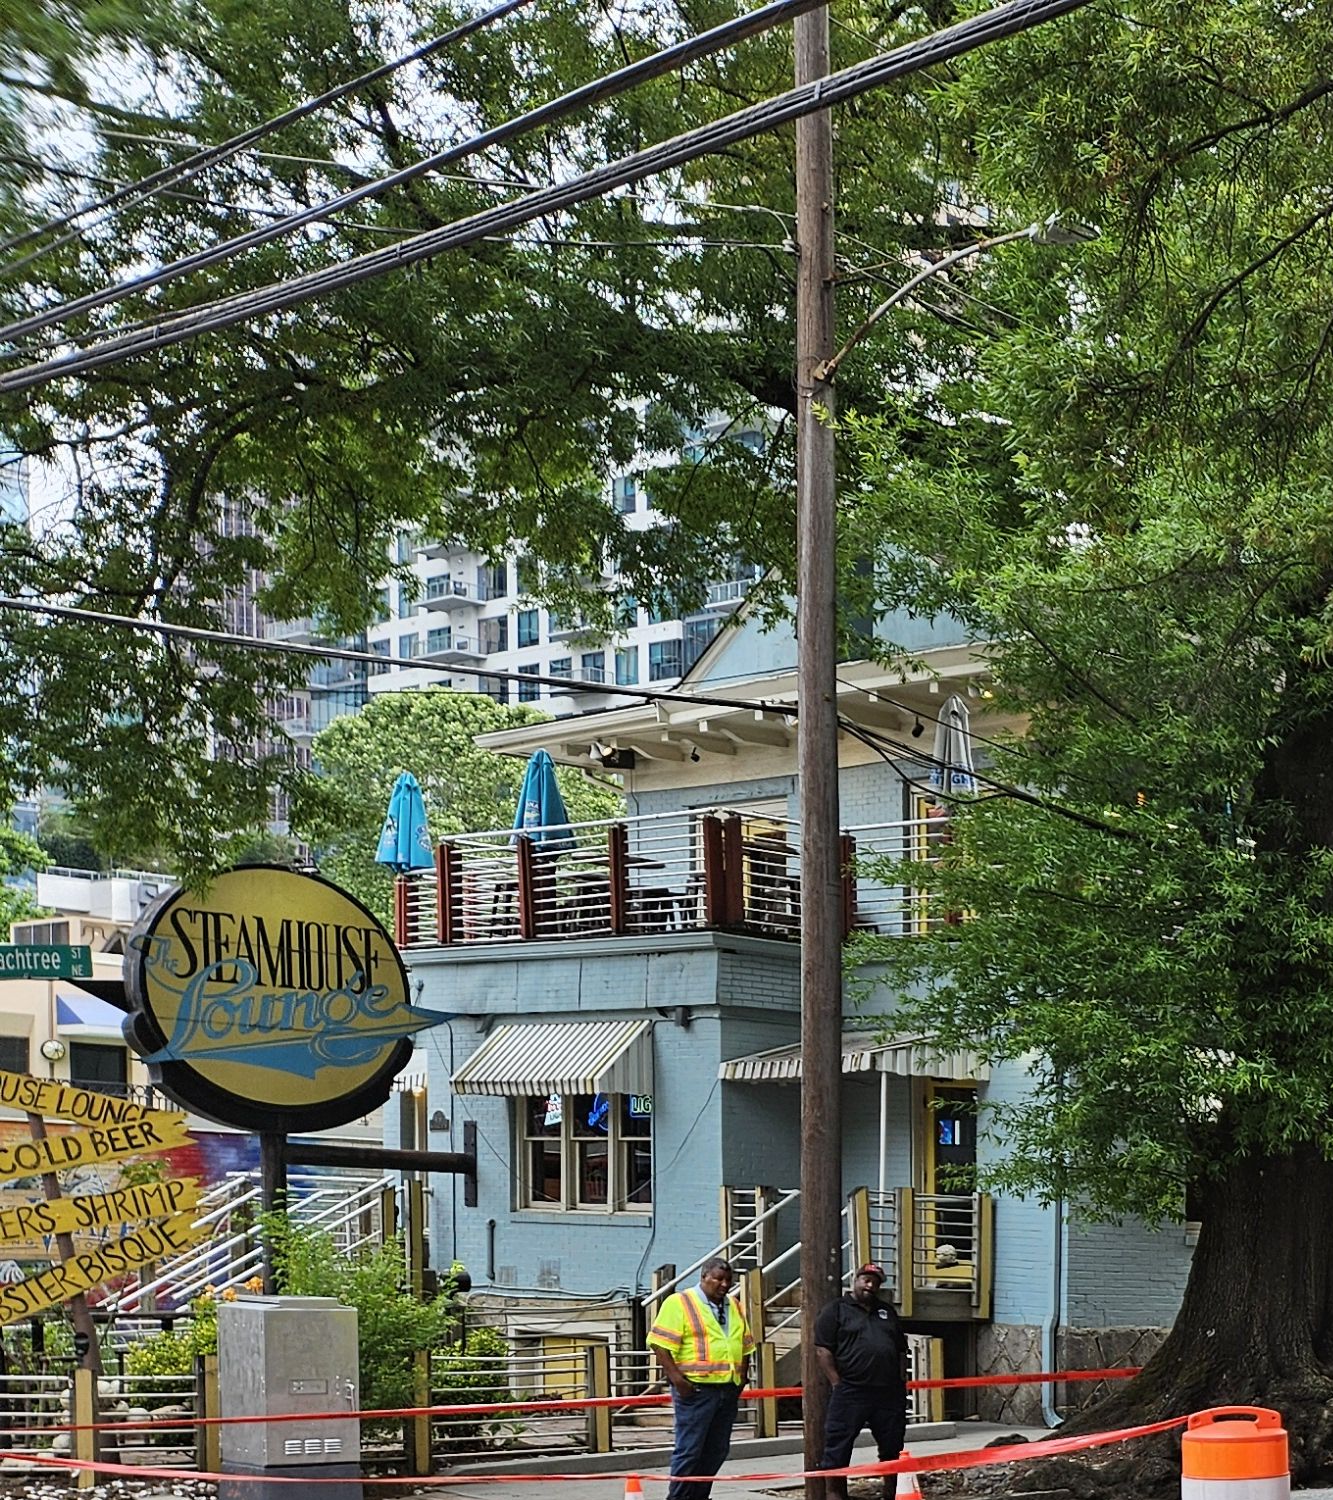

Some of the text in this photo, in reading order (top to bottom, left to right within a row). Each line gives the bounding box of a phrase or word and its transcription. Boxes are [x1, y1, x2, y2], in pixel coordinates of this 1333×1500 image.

[71, 947, 81, 959] ST
[71, 964, 84, 976] NE
[170, 907, 384, 996] STEAMHOUSE
[164, 958, 406, 1066] Lounge
[90, 1121, 163, 1157] BEER
[72, 1180, 185, 1227] SHRIMP
[76, 1217, 188, 1284] BISQUE
